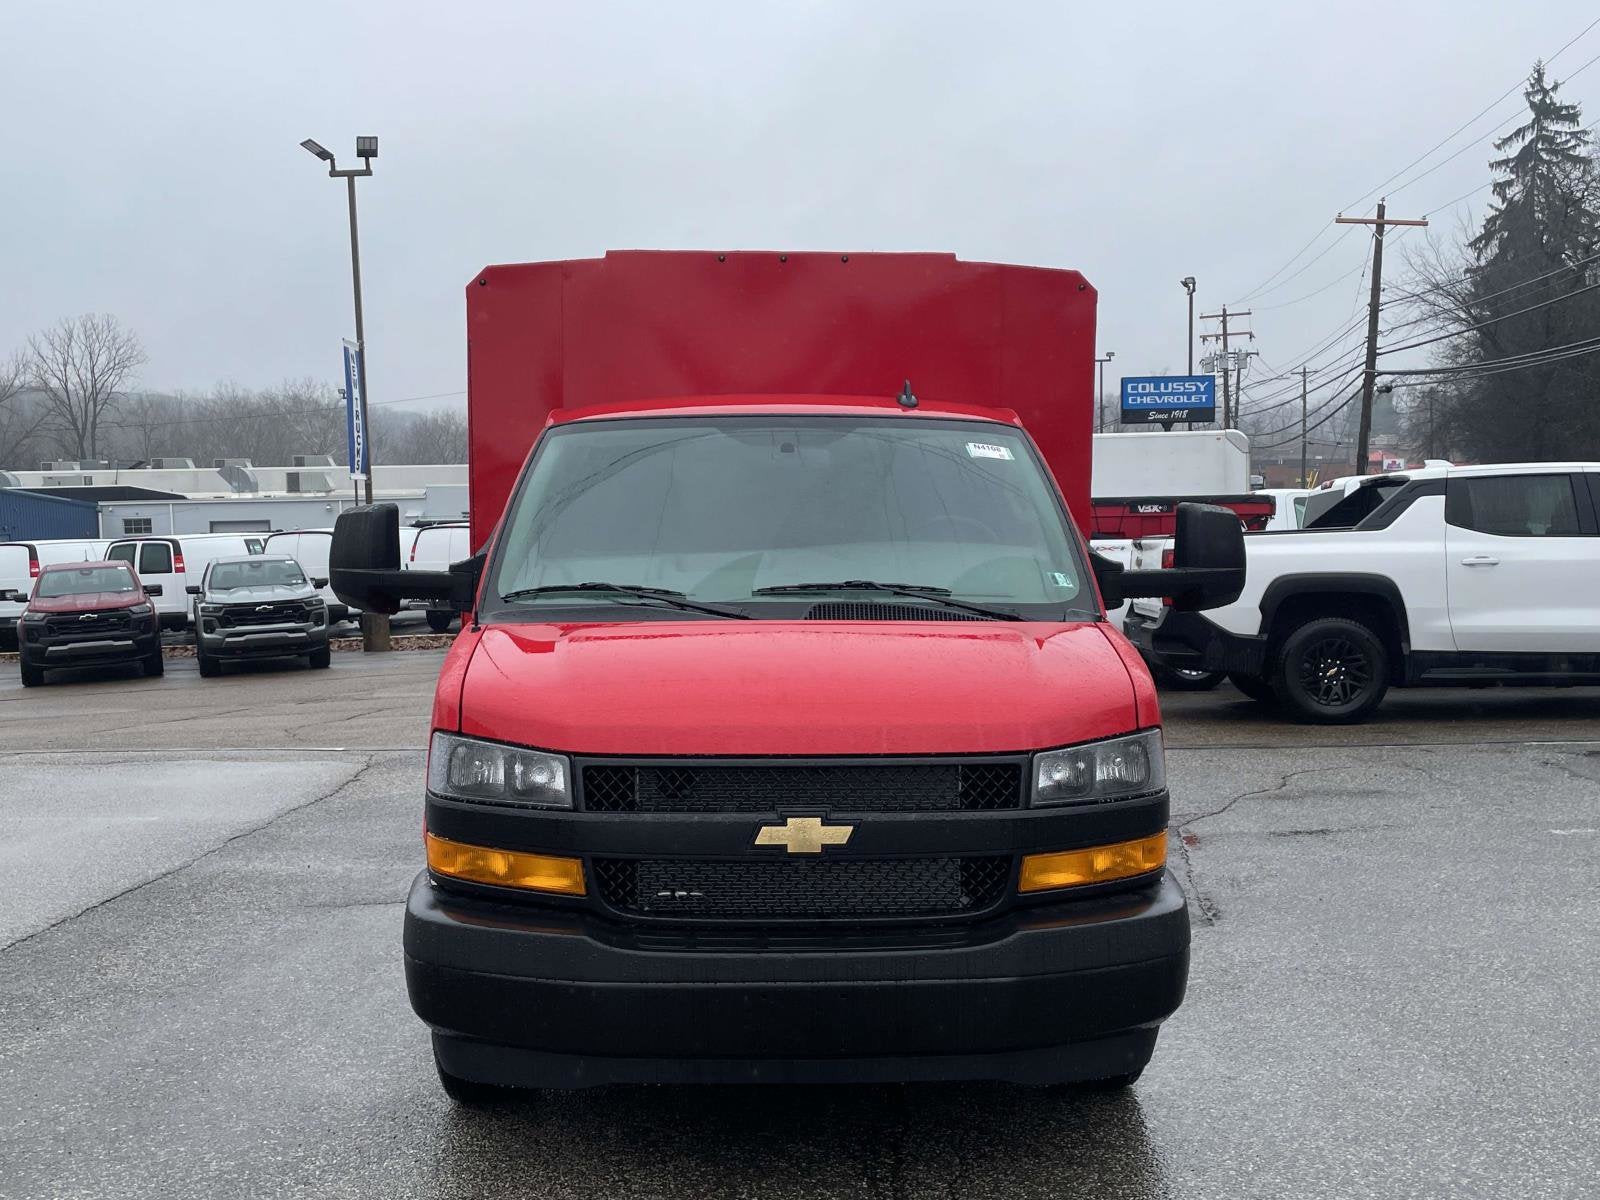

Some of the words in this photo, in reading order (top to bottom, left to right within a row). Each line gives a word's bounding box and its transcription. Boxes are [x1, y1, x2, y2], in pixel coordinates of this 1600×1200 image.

[1127, 382, 1208, 393] COLUSSY
[1128, 394, 1208, 404] CHEVROLET
[1148, 411, 1168, 420] Since
[1171, 409, 1188, 418] 1918
